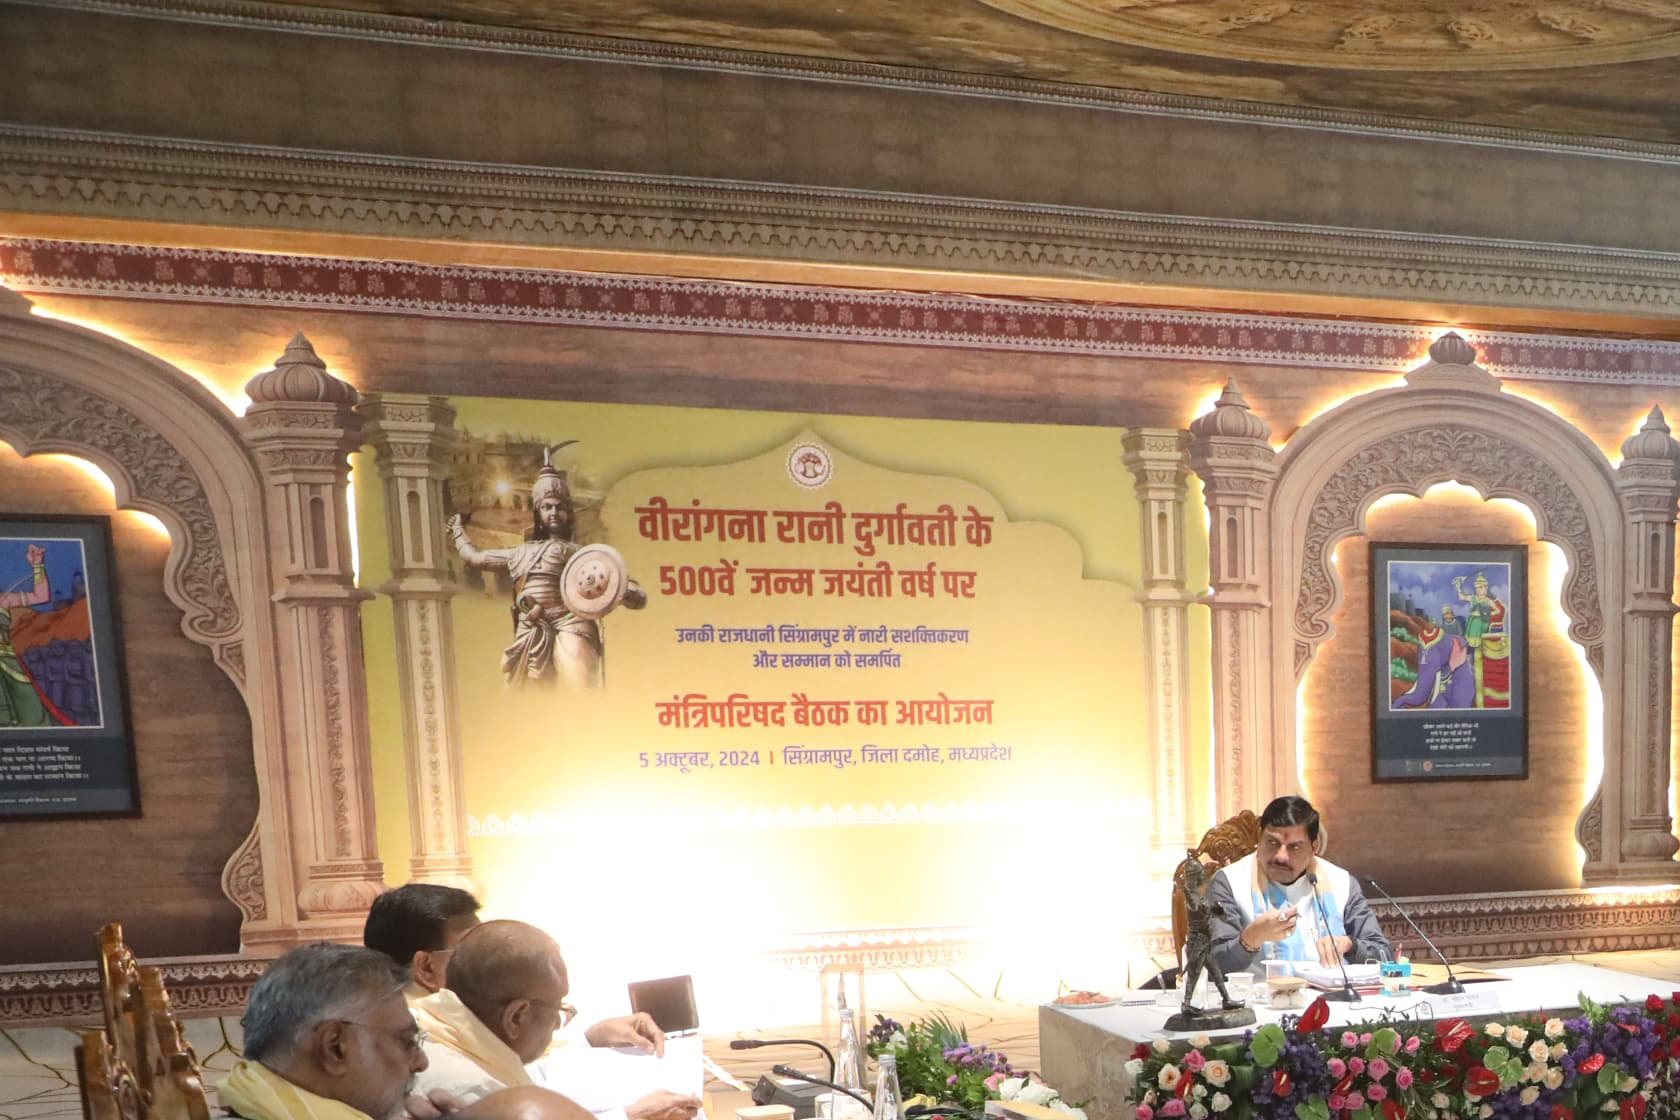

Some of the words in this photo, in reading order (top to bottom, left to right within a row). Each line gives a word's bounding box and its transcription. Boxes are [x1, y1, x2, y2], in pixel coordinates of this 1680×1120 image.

[634, 496, 768, 543] वीरांगना
[772, 501, 846, 544] रानी
[851, 503, 958, 557] दुर्गावती
[962, 506, 994, 547] के
[660, 558, 739, 596] 500वें
[745, 568, 815, 596] जन्म
[819, 561, 894, 597] जयंती
[898, 562, 936, 598] वर्ष
[940, 571, 977, 598] पर
[675, 624, 715, 643] उनकी
[717, 624, 776, 643] राजधानी
[778, 624, 840, 648] सिंग्रामपुर
[842, 625, 857, 643] में
[858, 625, 888, 643] नारी
[890, 625, 969, 643] सशक्तिकरण
[753, 650, 779, 668] और
[780, 654, 831, 668] सम्मान
[834, 650, 852, 668] को
[854, 648, 901, 668] समर्पित
[655, 693, 787, 728] मंत्रिपरिषद
[790, 693, 851, 726] बैठक
[854, 701, 888, 726] का
[896, 692, 994, 725] आयोजन
[640, 752, 648, 768] 5
[656, 752, 714, 773] अक्टूबर,
[720, 751, 760, 766] 2024
[782, 745, 856, 768] सिंग्रामपुर,
[860, 744, 899, 763] जिला
[902, 744, 944, 764] दमोह,
[947, 743, 1012, 762] मध्यप्रदेश
